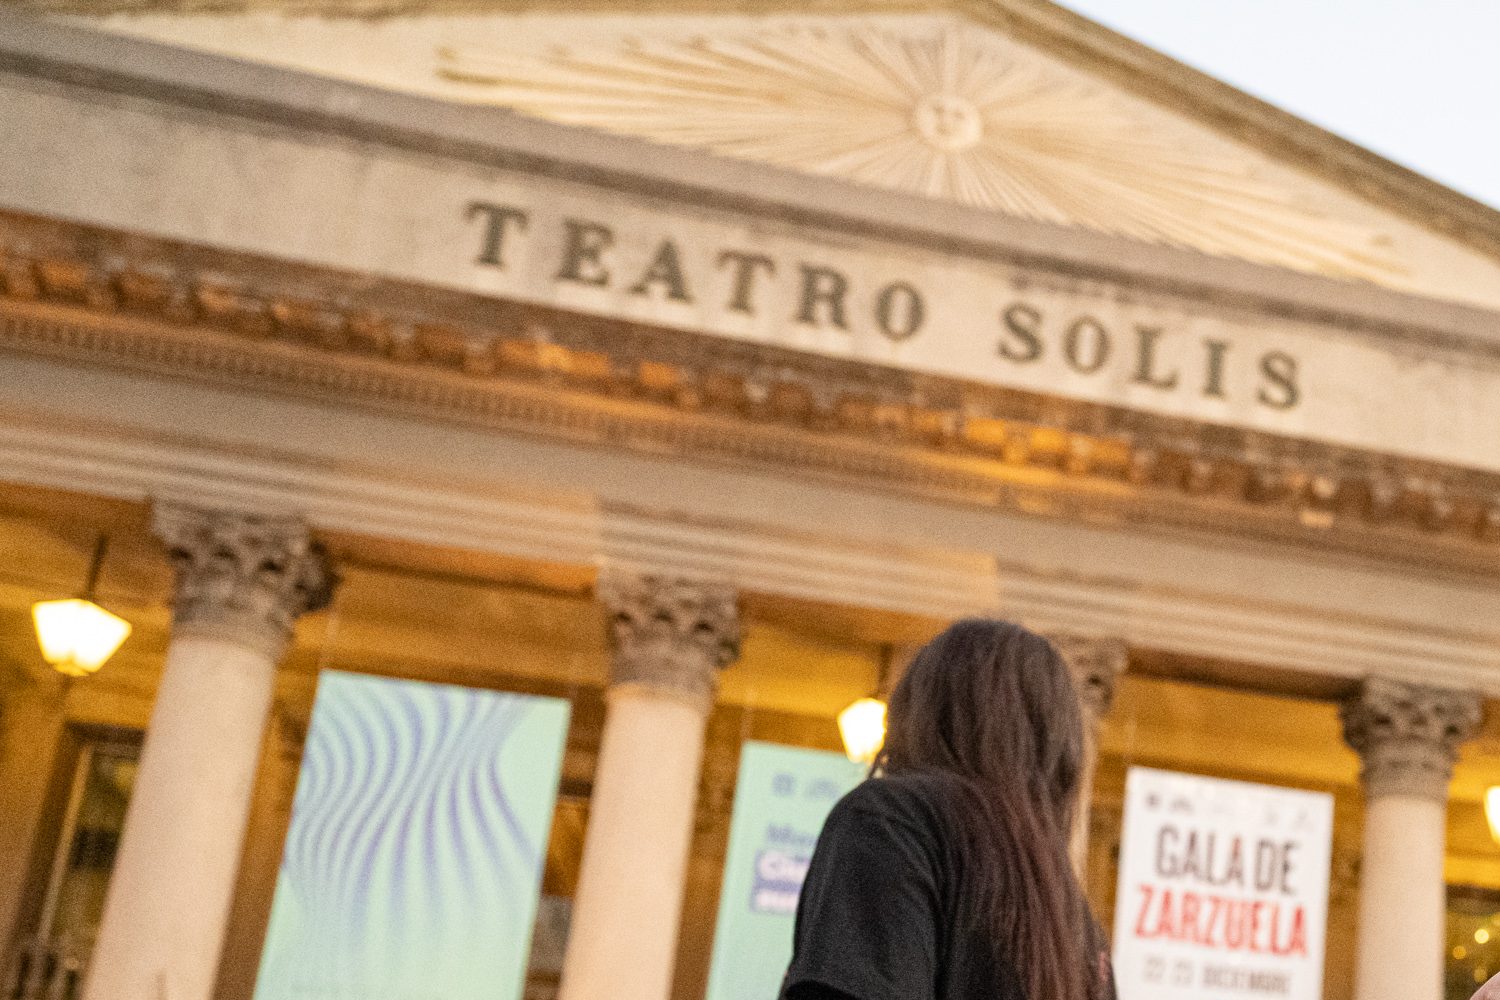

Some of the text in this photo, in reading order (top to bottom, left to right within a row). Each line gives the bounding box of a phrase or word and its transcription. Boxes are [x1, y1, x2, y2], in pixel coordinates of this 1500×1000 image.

[464, 201, 1303, 411] TEATRO SOLIS
[1157, 825, 1298, 895] GALA DE
[1135, 885, 1307, 956] ZARZUELA
